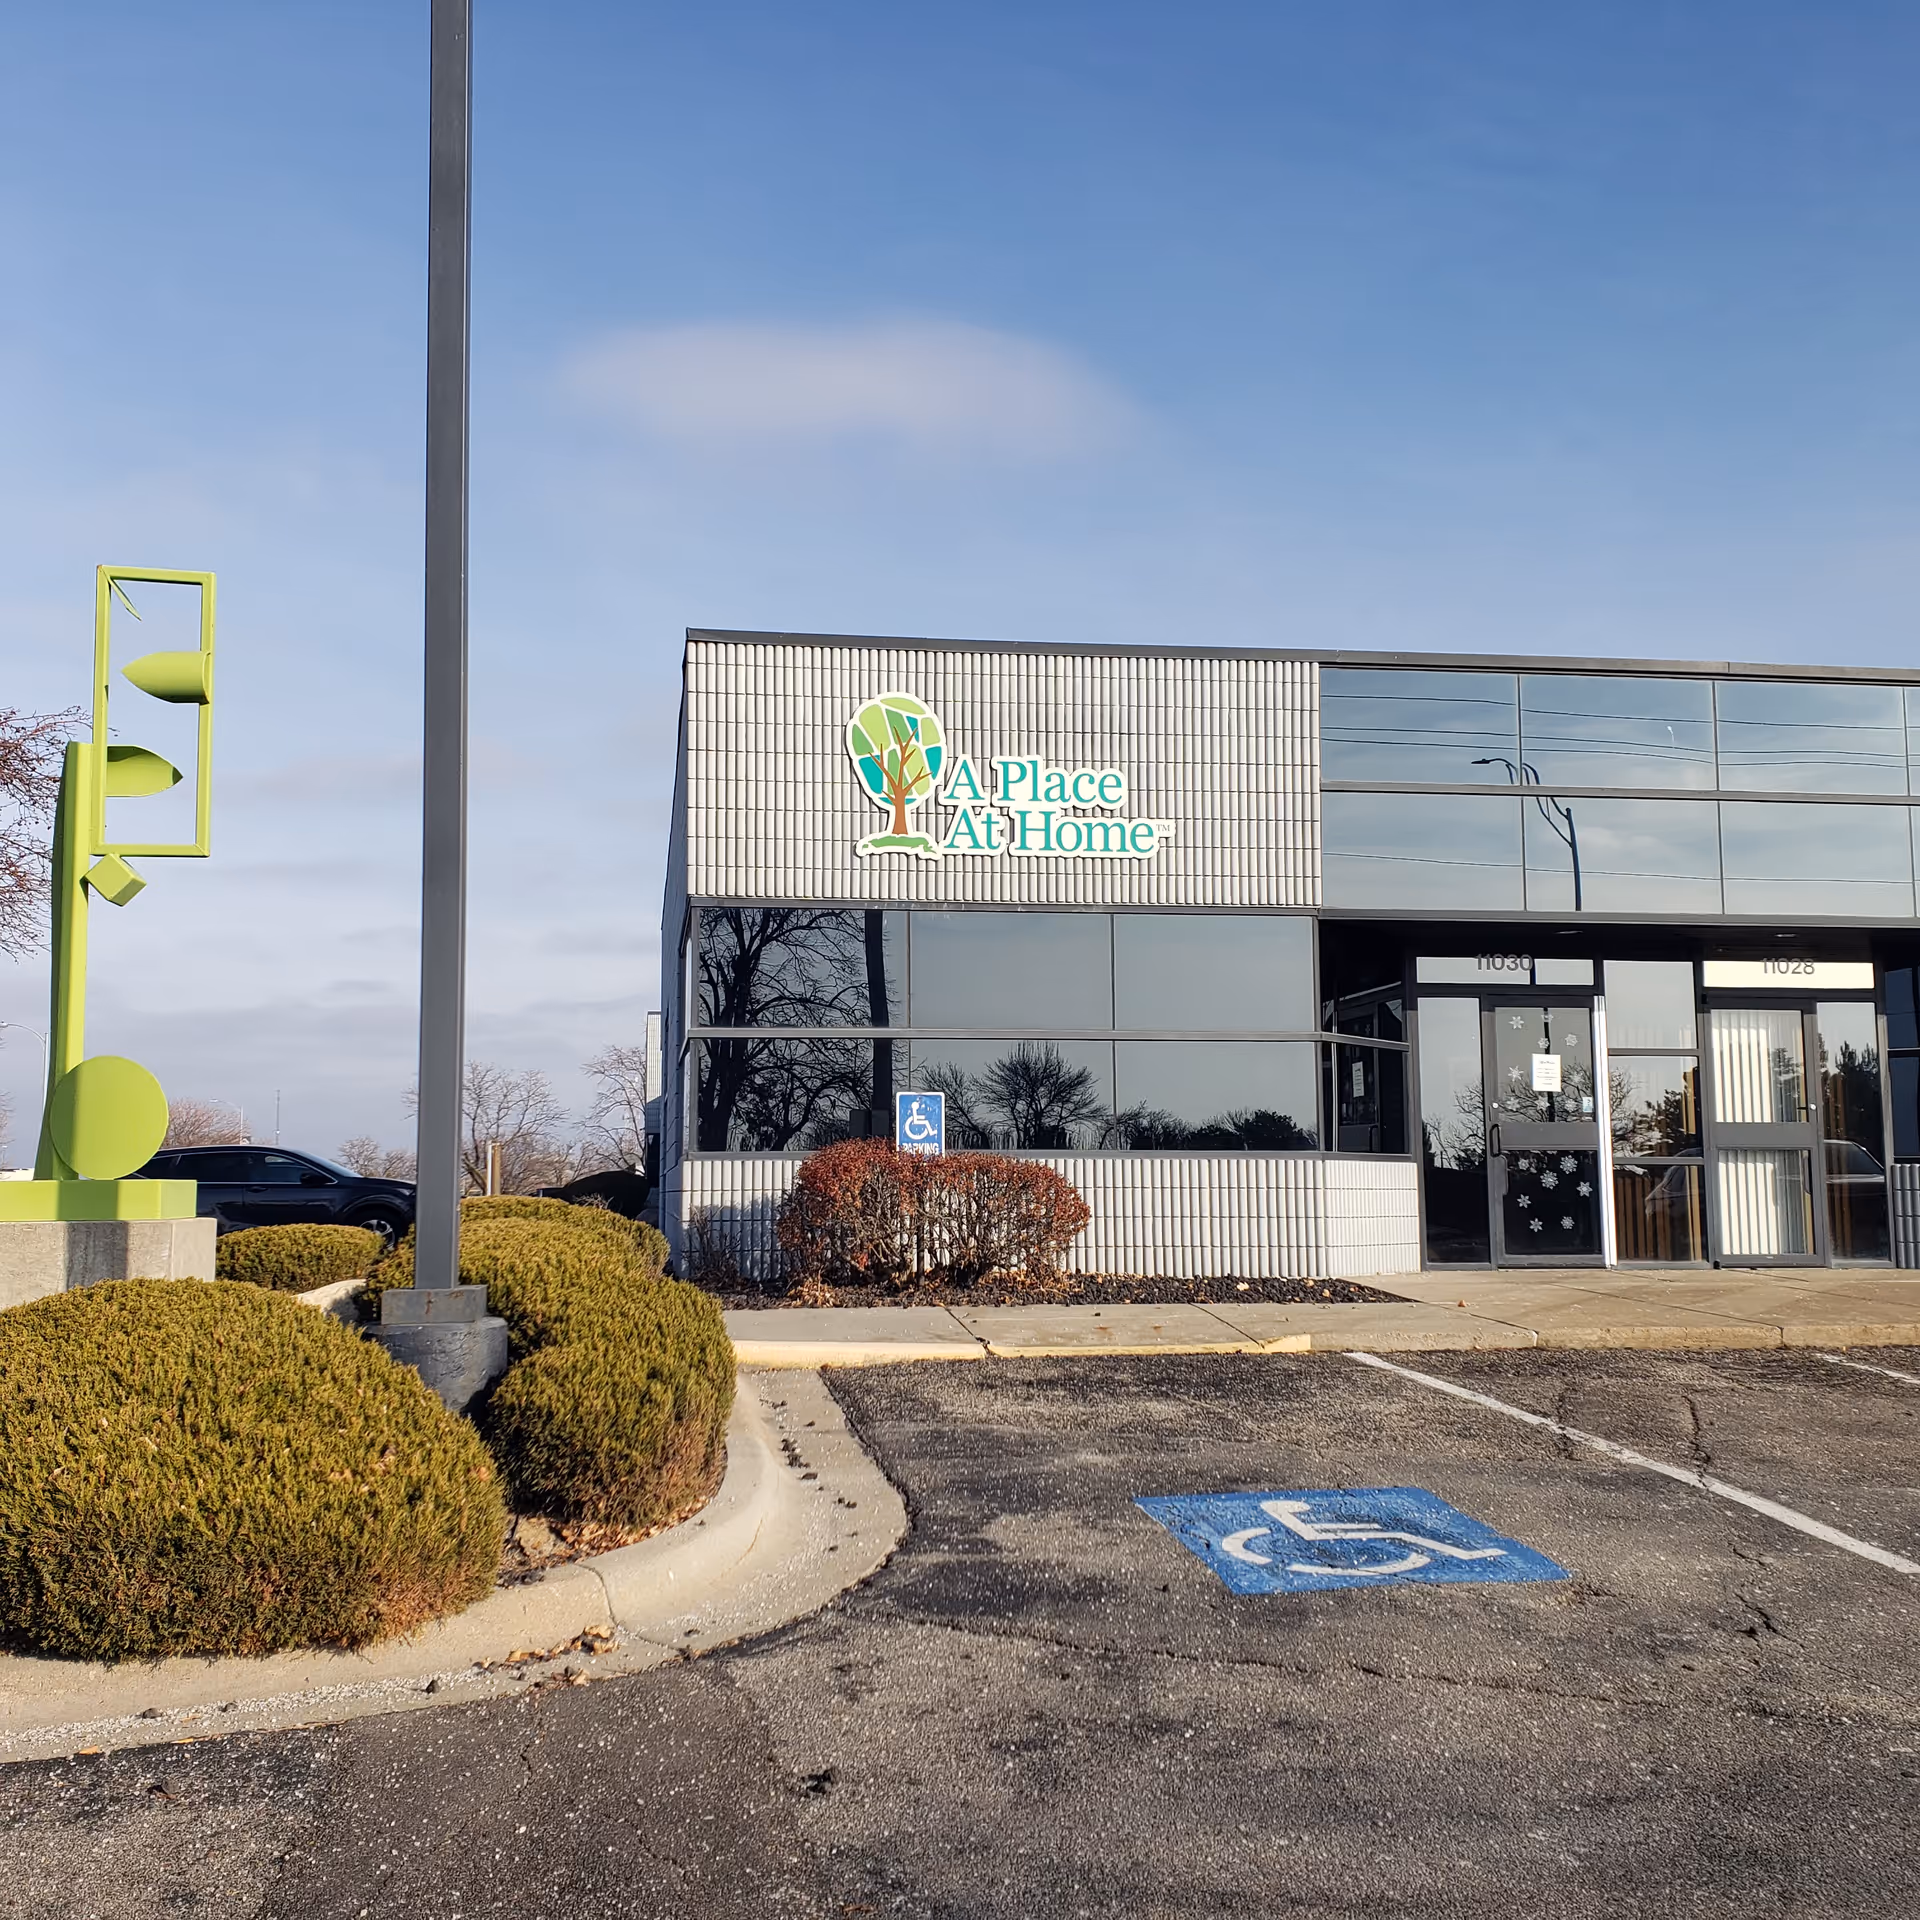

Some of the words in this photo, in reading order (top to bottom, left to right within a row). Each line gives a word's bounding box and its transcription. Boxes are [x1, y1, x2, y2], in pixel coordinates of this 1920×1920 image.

[944, 759, 985, 801] A
[997, 760, 1123, 804] Place
[944, 808, 1001, 850] At
[1015, 810, 1154, 853] Home
[1475, 953, 1533, 971] 11030
[1760, 957, 1815, 975] 11028
